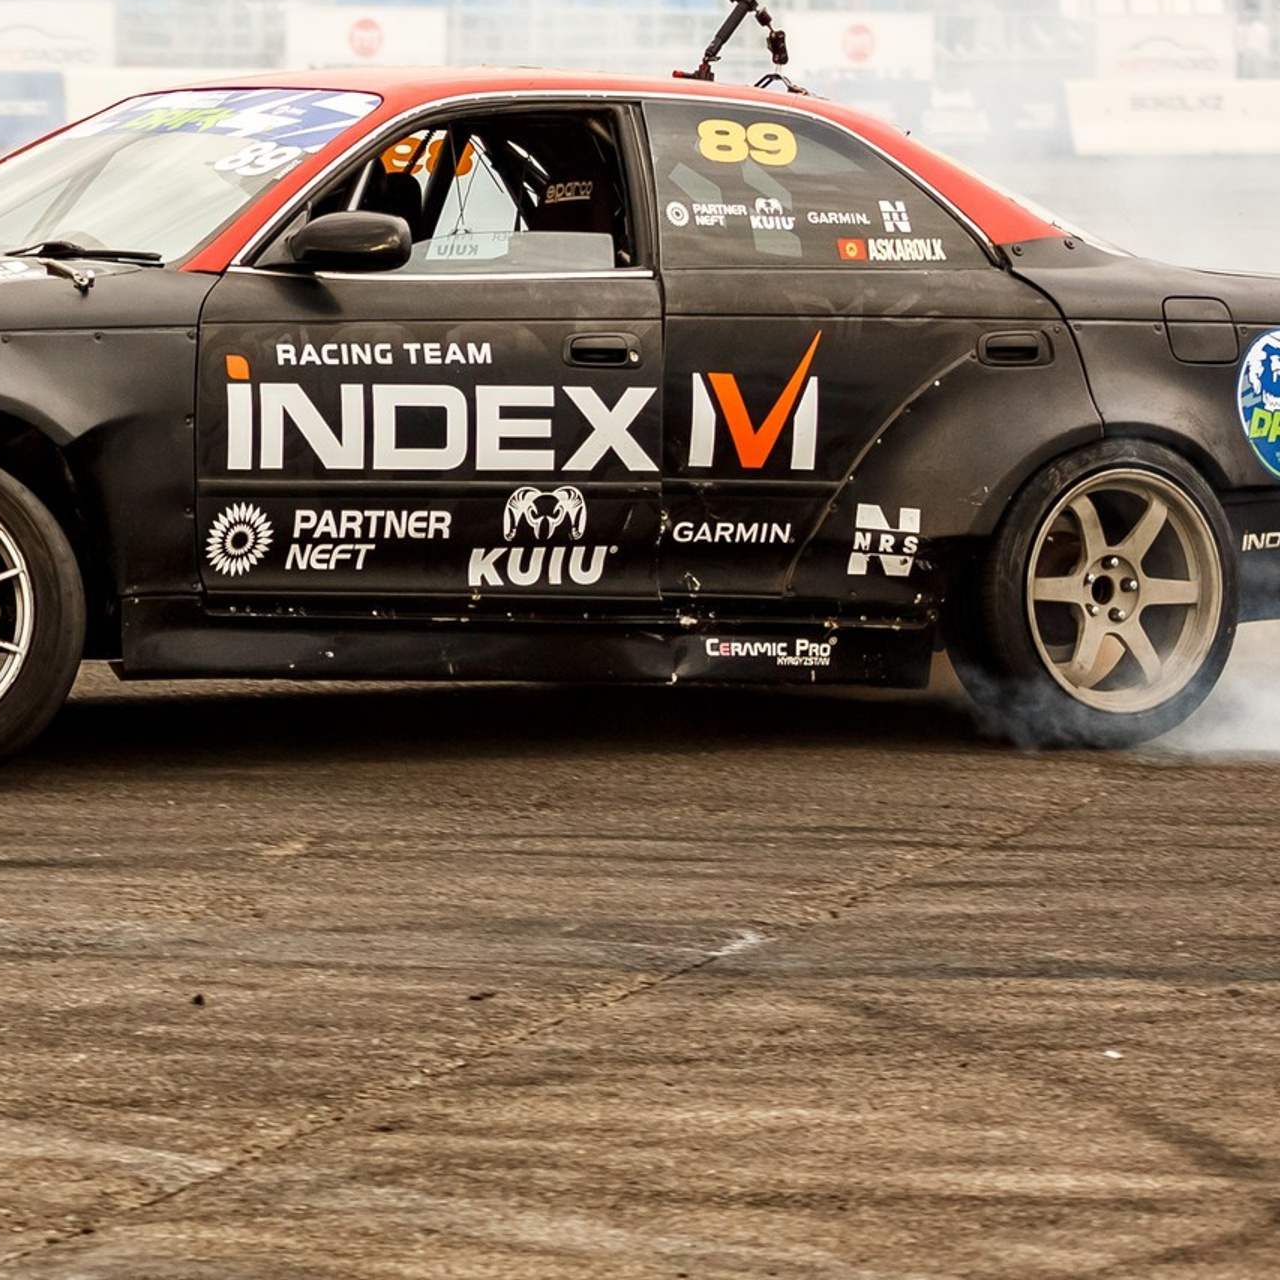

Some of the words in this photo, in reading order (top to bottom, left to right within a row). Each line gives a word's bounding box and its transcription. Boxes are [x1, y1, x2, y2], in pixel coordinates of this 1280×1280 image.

[698, 119, 797, 166] 89
[214, 141, 302, 176] 89
[692, 203, 748, 216] PARTNER
[695, 215, 726, 226] NEFT
[807, 211, 869, 225] GARMIN
[750, 215, 795, 230] KUIU
[867, 238, 947, 262] ASKAROV.K
[276, 343, 393, 366] RACING
[403, 342, 493, 365] TEAM
[293, 509, 452, 539] PARTNER
[673, 521, 792, 544] GARMIN
[285, 543, 375, 571] NEFT
[468, 546, 608, 587] KUIU
[776, 656, 830, 666] KYRGYZSTAN
